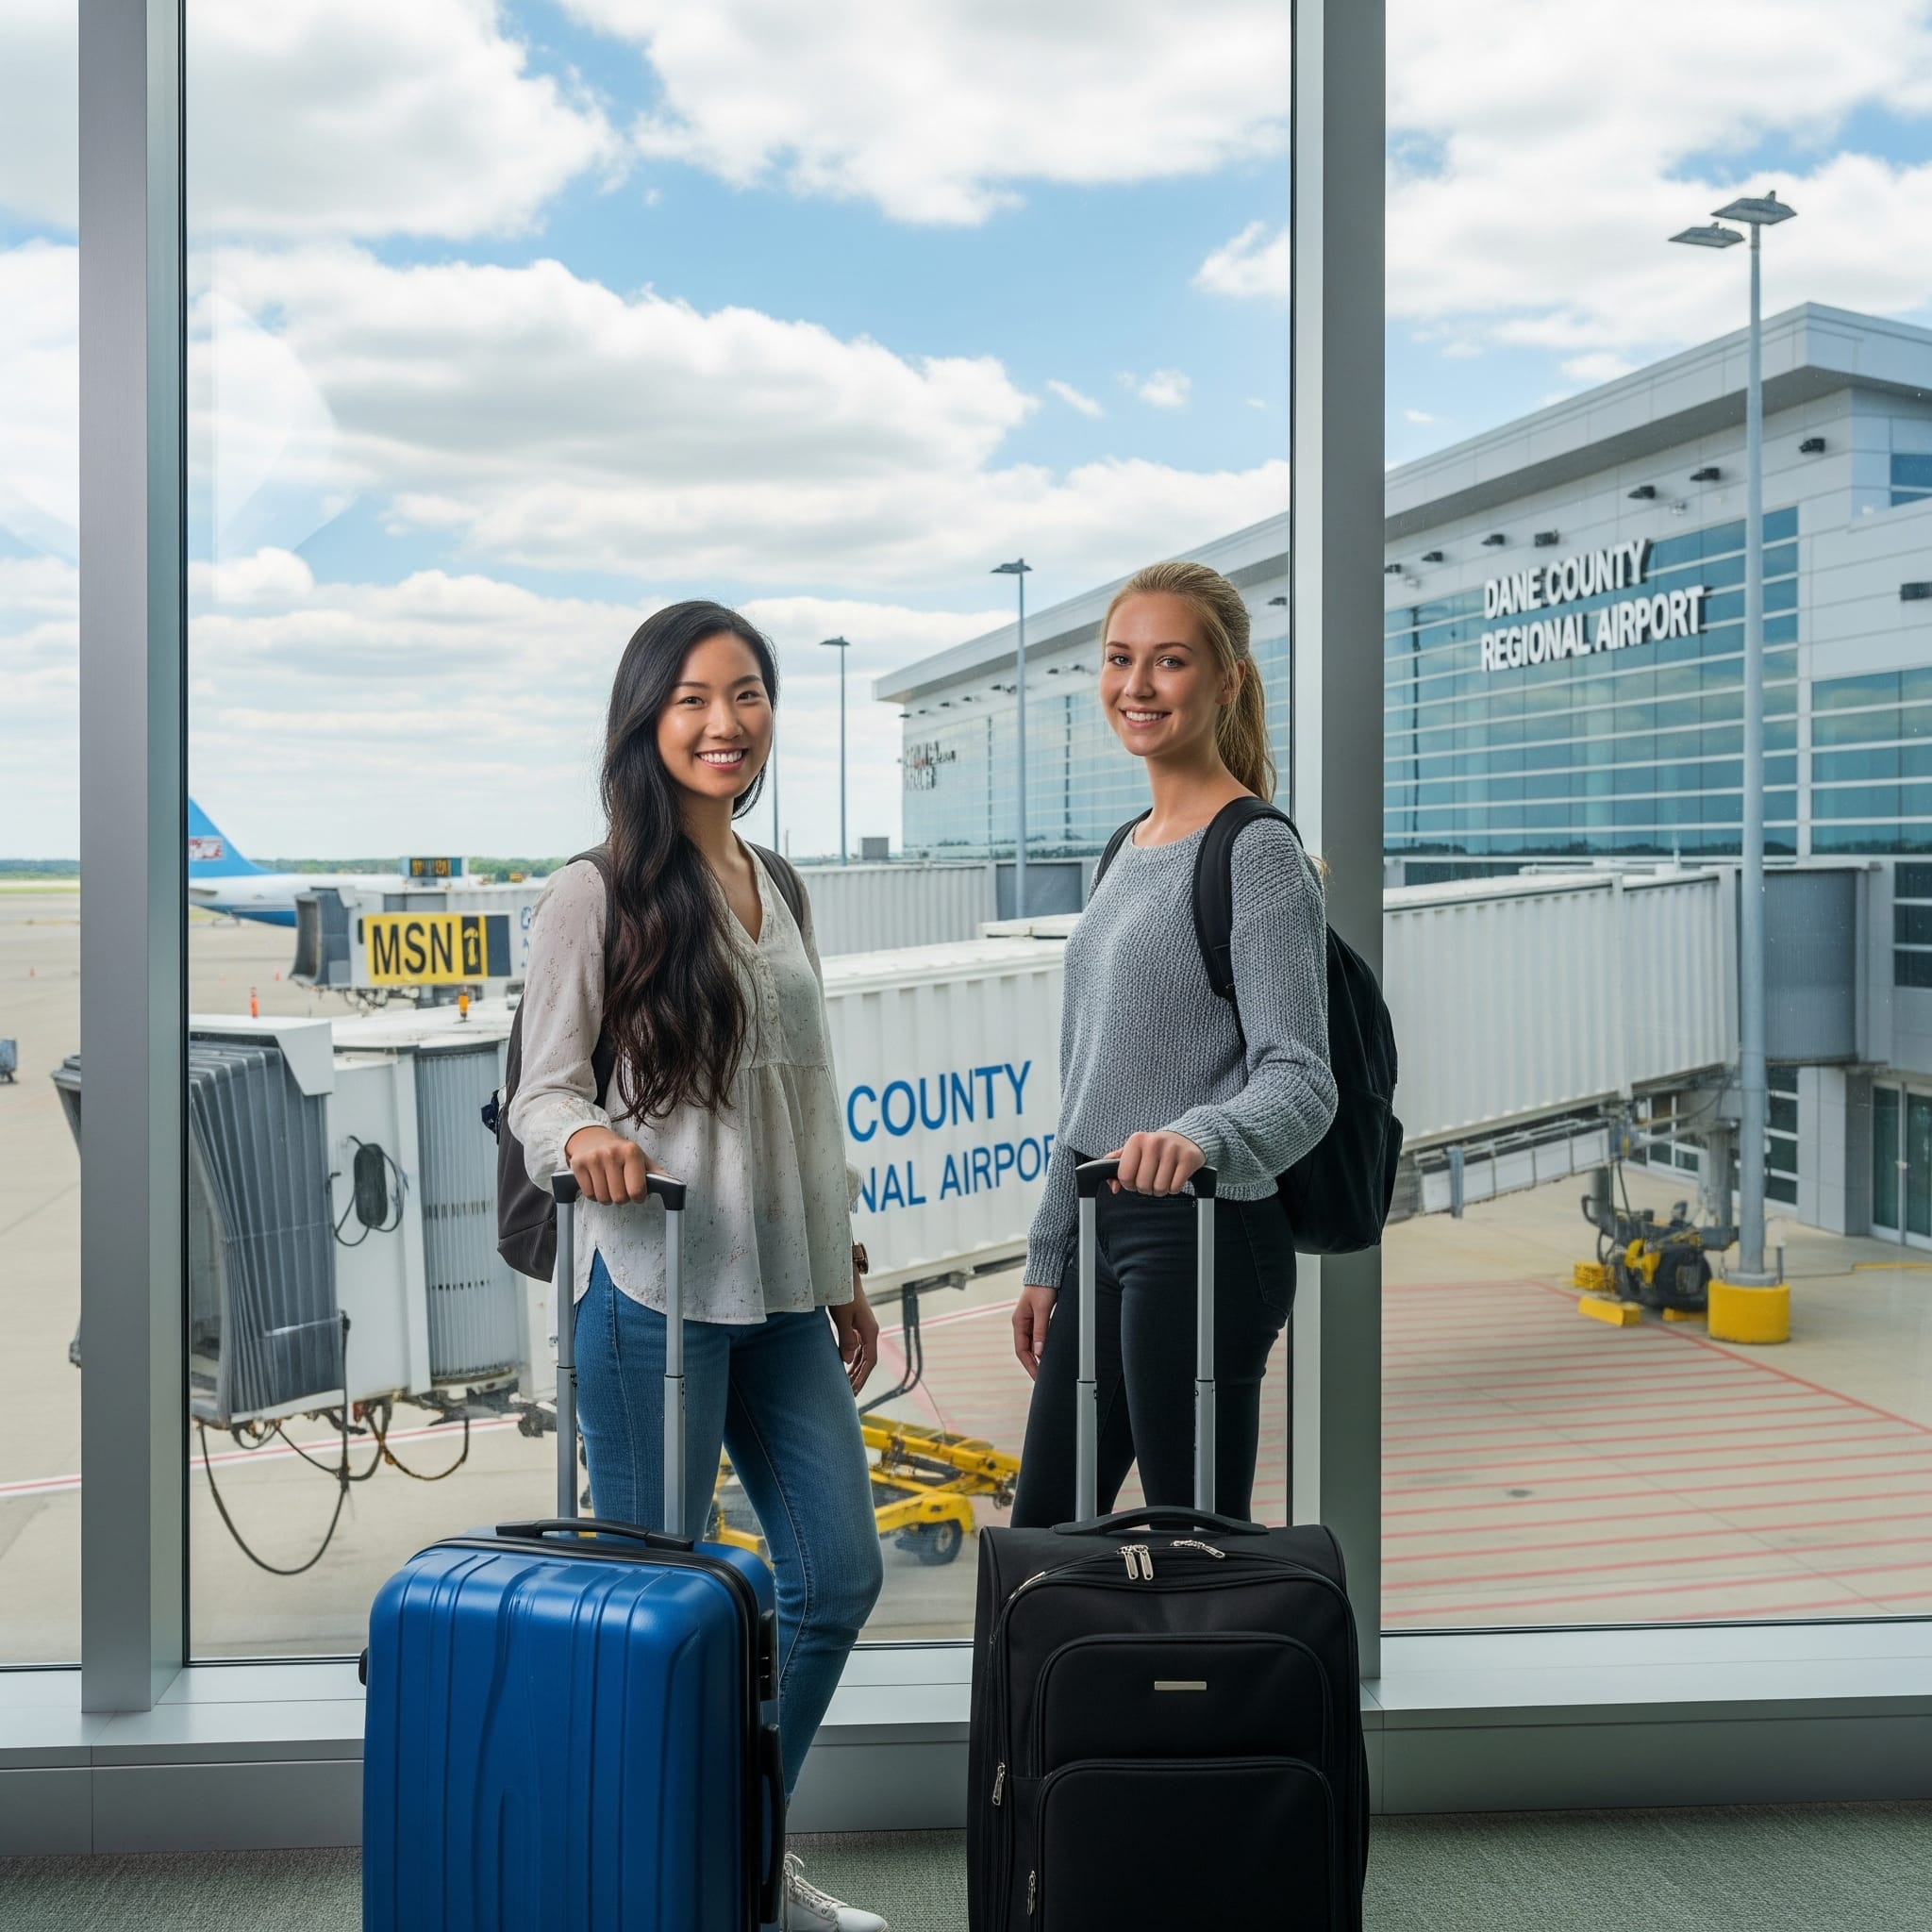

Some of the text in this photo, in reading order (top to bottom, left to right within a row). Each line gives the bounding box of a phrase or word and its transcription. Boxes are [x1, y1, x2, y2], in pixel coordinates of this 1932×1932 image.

[1484, 538, 1650, 620] DANE COUNTY
[1481, 584, 1706, 672] REGIONAL AIRPORT
[373, 922, 453, 976] MSN
[847, 1059, 1032, 1142] COUNTY
